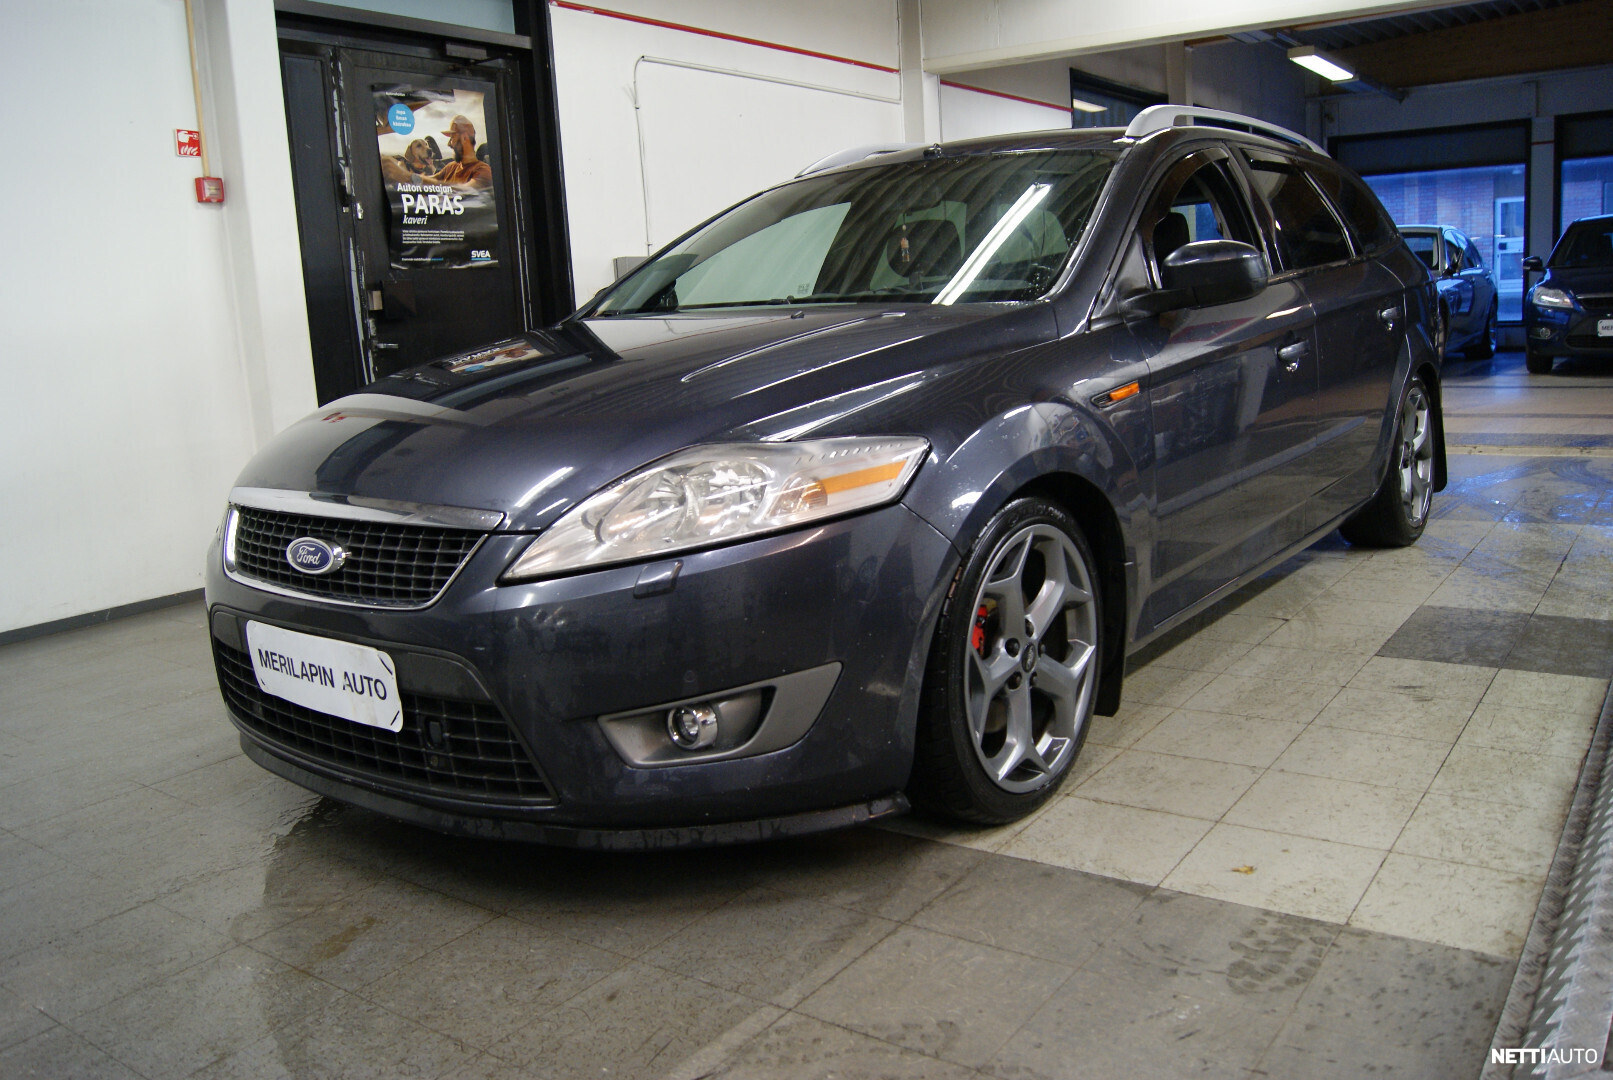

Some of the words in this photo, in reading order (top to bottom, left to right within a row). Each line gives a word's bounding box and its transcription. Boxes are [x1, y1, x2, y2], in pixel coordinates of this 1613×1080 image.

[397, 183, 422, 192] Auton
[423, 184, 453, 194] ostajan
[401, 194, 464, 215] PARAS
[402, 215, 428, 225] kaveri
[471, 250, 491, 258] SVEA
[296, 545, 322, 565] Ford
[258, 648, 335, 688] MERILAPIN
[342, 671, 387, 700] AUTO
